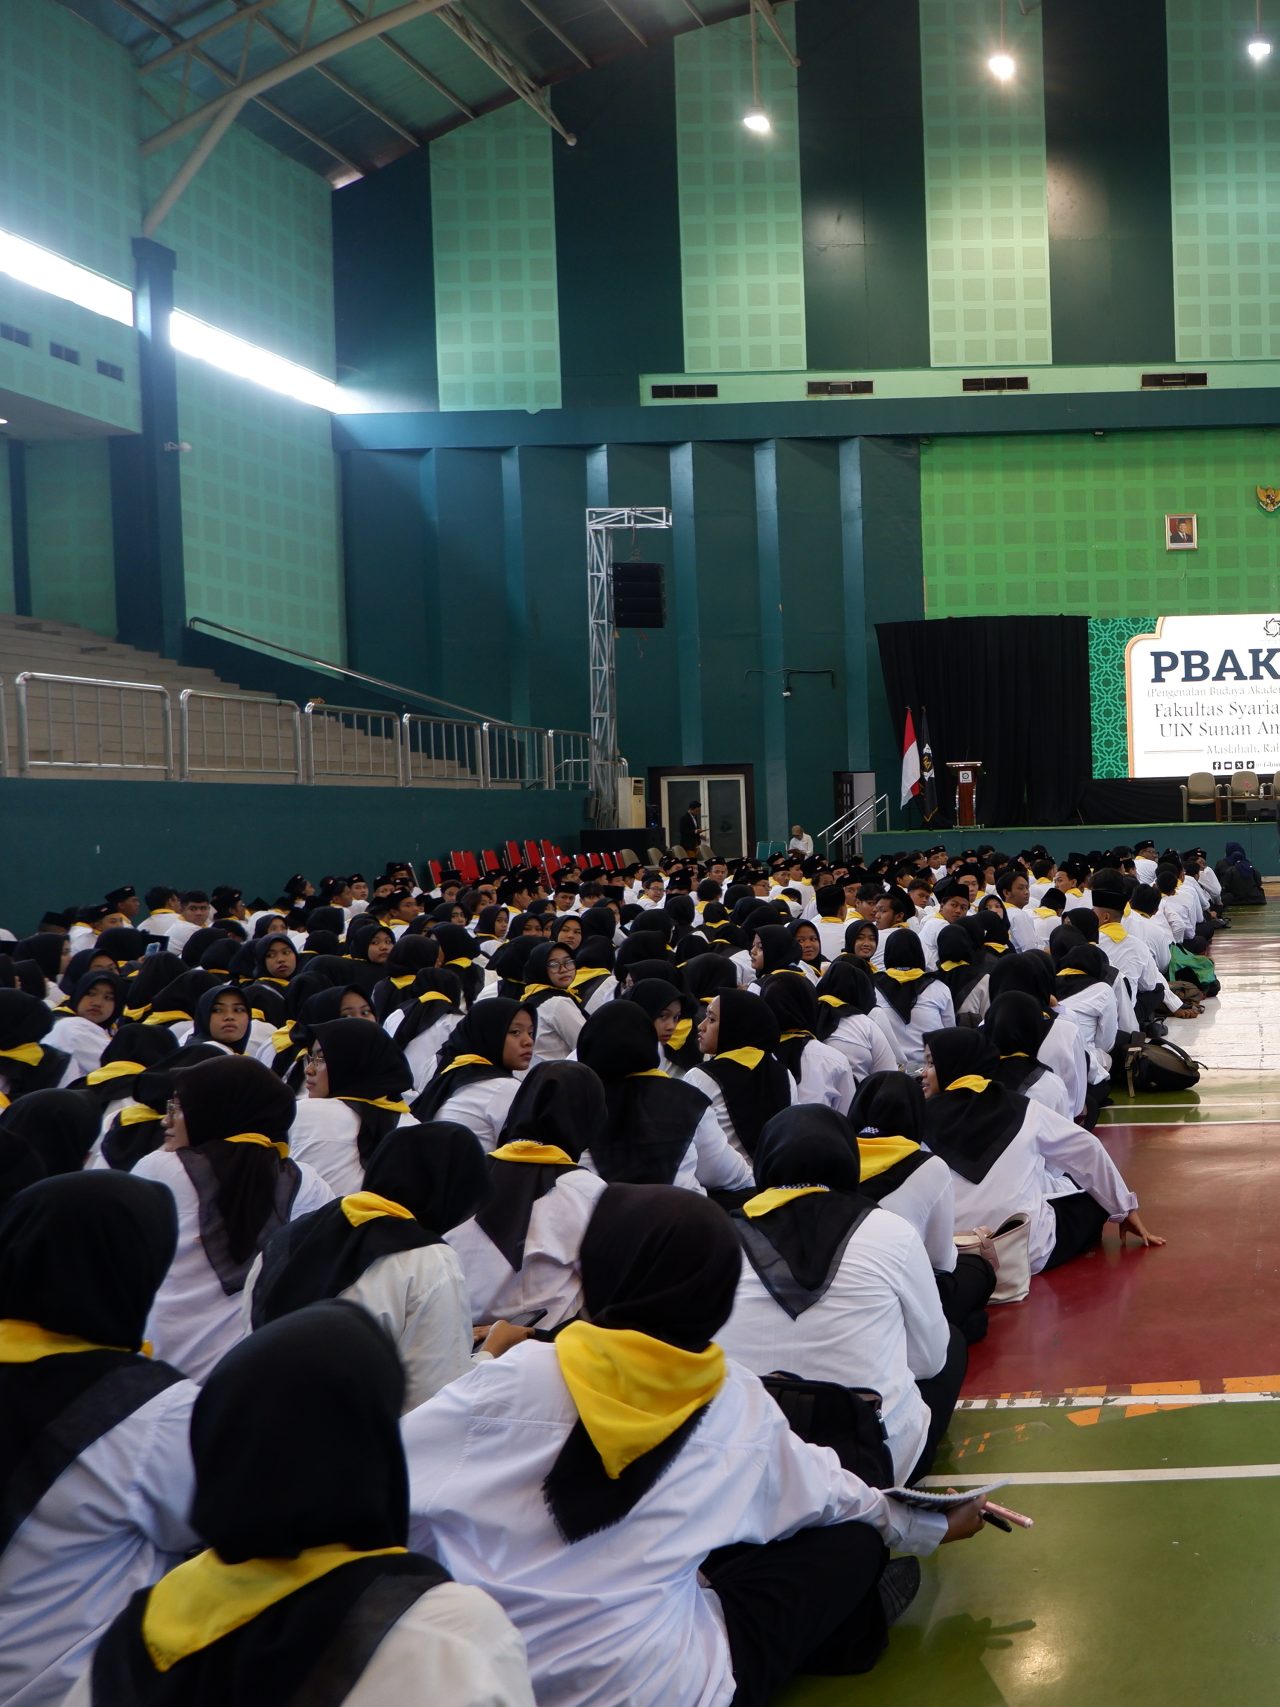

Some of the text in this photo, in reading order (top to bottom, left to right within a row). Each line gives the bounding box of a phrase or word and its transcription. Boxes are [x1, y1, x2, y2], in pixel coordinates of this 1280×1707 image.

[1209, 686, 1245, 698] Budaya
[1154, 701, 1224, 718] Fakultas
[1160, 722, 1193, 738] UIN
[1199, 722, 1251, 737] Sunan
